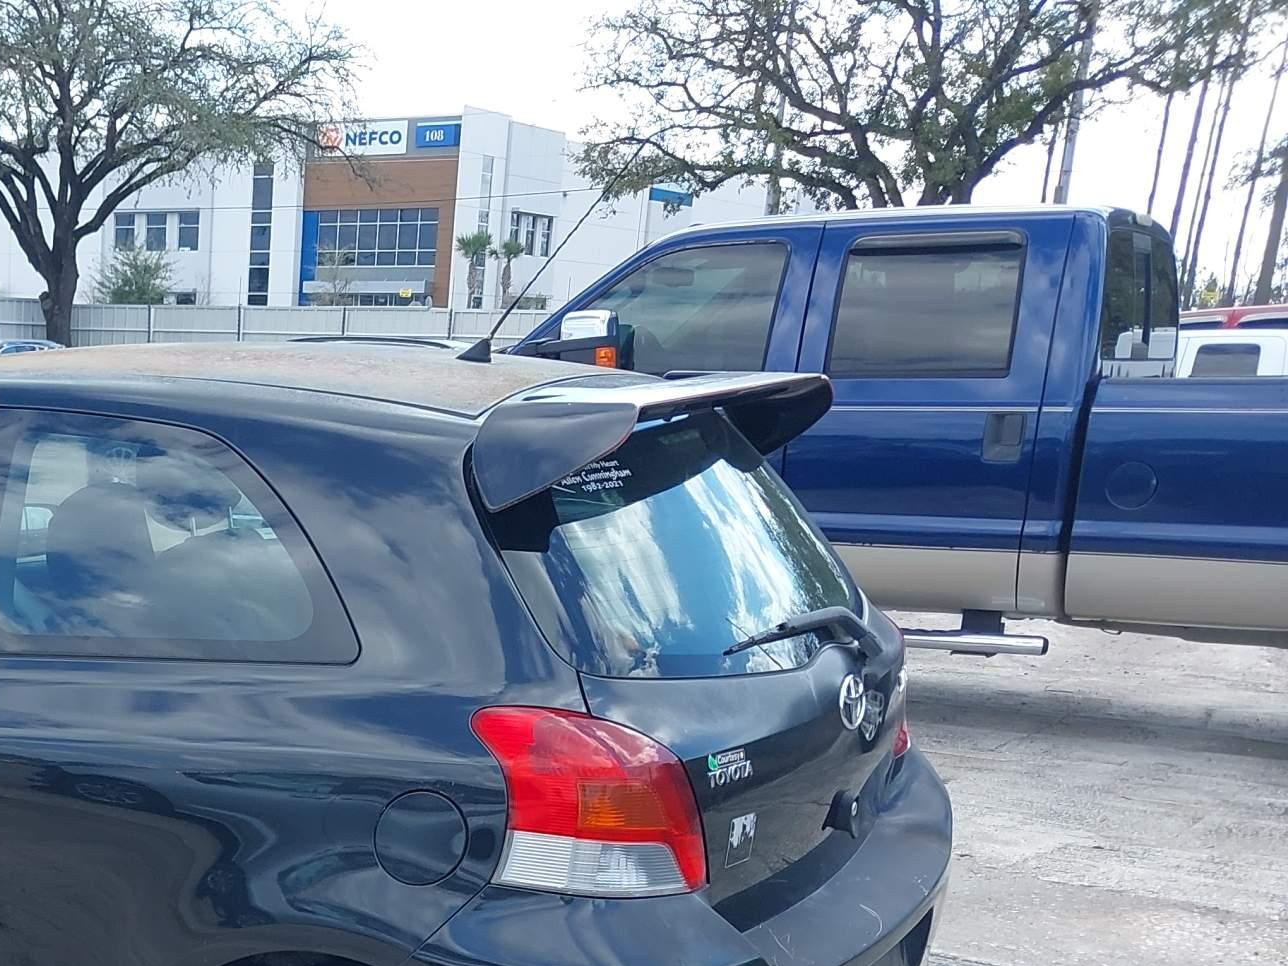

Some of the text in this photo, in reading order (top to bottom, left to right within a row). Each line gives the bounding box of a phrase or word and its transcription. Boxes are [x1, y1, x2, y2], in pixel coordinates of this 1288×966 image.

[344, 130, 402, 147] NEFCO
[424, 129, 444, 142] 108
[581, 480, 623, 493] 1982-2021
[707, 760, 753, 788] TOYOTA
